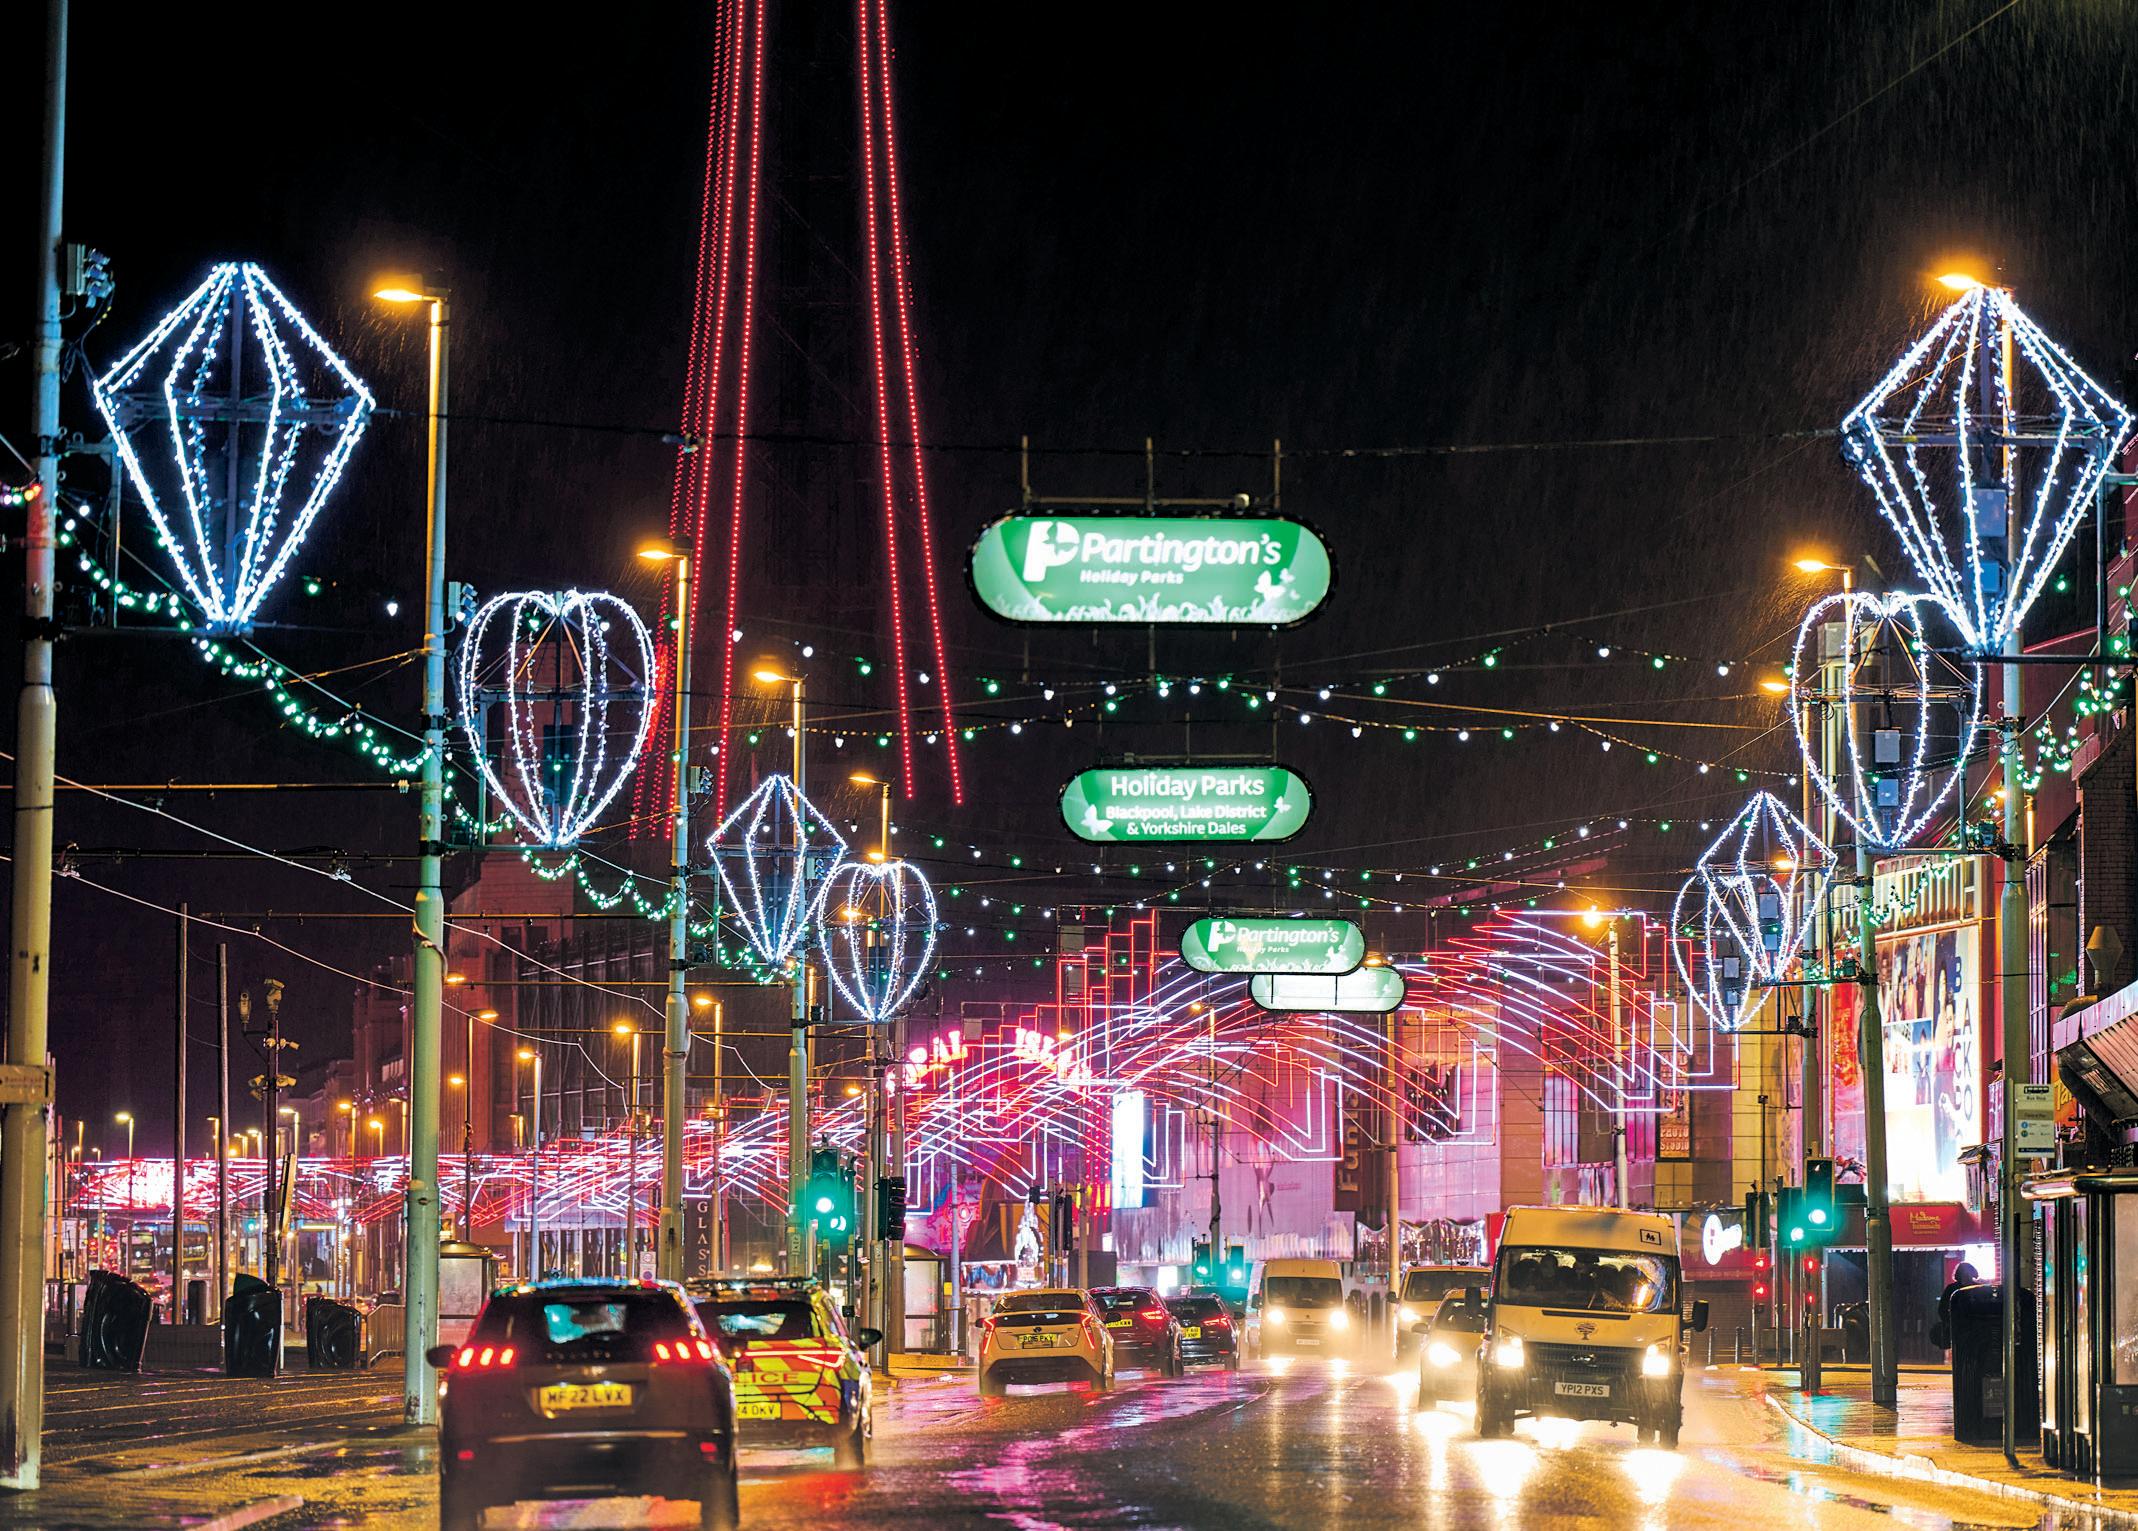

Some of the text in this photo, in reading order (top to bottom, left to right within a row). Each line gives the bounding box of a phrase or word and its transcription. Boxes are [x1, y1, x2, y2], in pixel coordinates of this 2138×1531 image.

[1081, 532, 1282, 572] Partington's
[1080, 569, 1184, 587] Holiday Parks
[1111, 772, 1265, 801] Holiday Parks
[1105, 805, 1267, 821] Blackpool, Lake District
[1127, 822, 1246, 835] & Yorkshire Dales
[1237, 927, 1340, 946] Partington's
[1660, 1127, 1689, 1138] PHOTO
[1660, 1140, 1689, 1150] STUDIO
[735, 1371, 801, 1384] LICE
[1561, 1384, 1604, 1396] YP12 PXS
